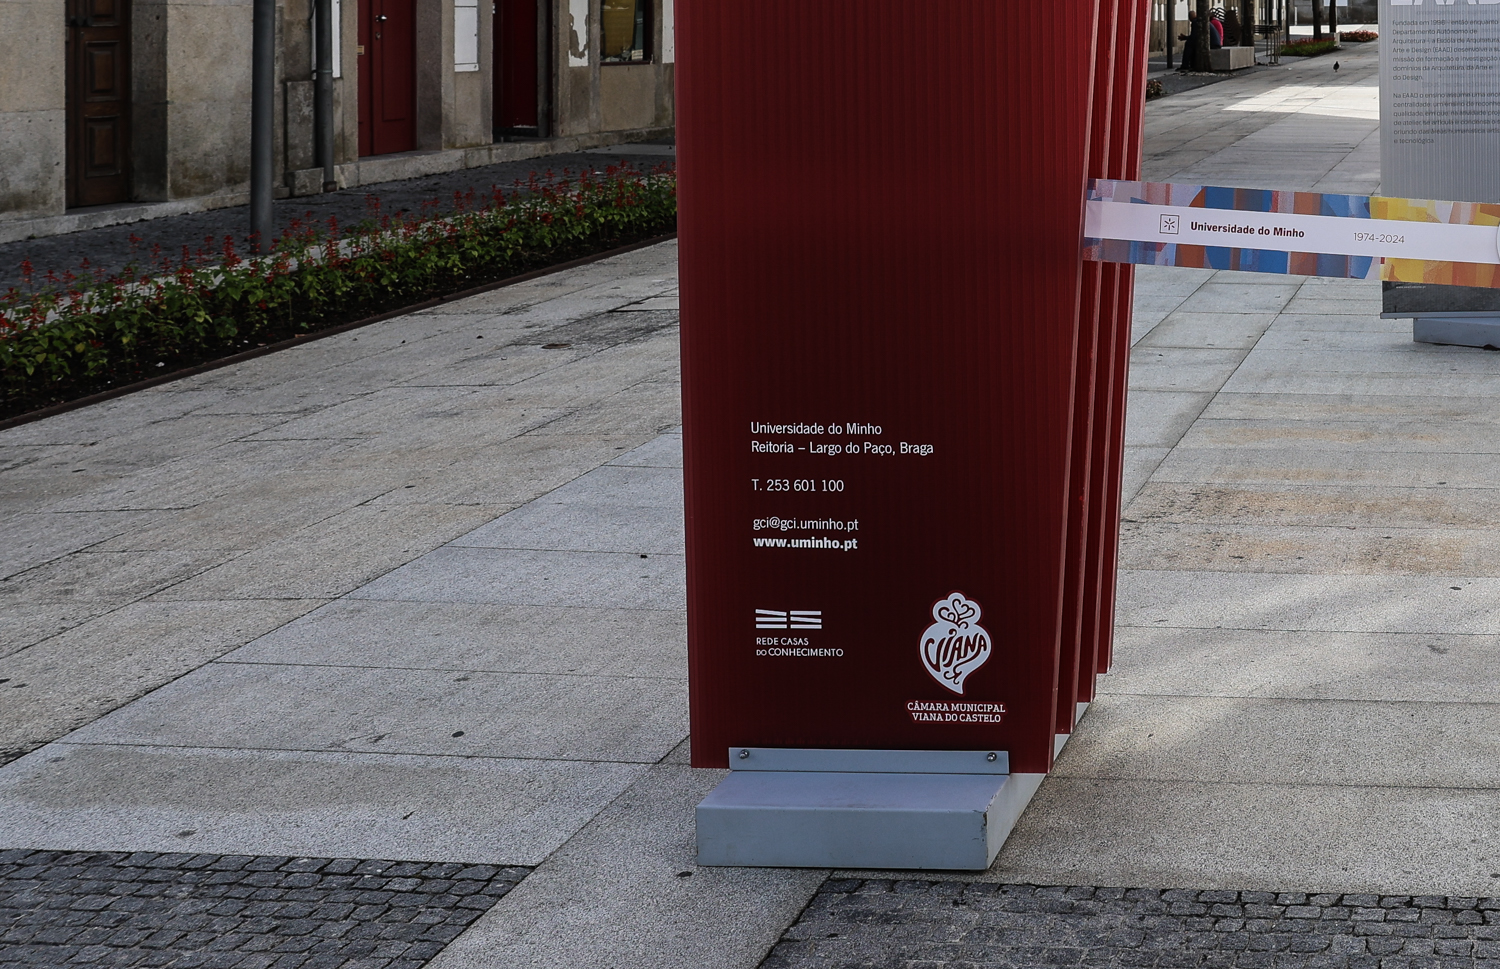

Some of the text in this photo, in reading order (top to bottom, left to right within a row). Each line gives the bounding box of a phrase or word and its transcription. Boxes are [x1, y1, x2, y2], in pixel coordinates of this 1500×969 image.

[1190, 221, 1304, 238] Universidade do Minho
[1353, 232, 1404, 244] 1974-2024
[750, 421, 882, 435] Universidade do Minho
[751, 440, 793, 453] Reitoria
[809, 441, 841, 456] Largo
[845, 441, 859, 454] do
[863, 441, 895, 456] Paço,
[899, 441, 933, 456] Braga
[751, 478, 844, 492] T. 253 601 100
[753, 516, 858, 532] gci@gci.uminho.pt
[753, 536, 857, 551] www.uminho.pt
[756, 637, 809, 646] REDE CASAS
[768, 647, 844, 657] CONHECIMENTO
[923, 629, 988, 672] VIANA
[907, 700, 1005, 712] CÂMARA MUNICIPAL
[911, 712, 1001, 723] VIANA DO CASTELO
